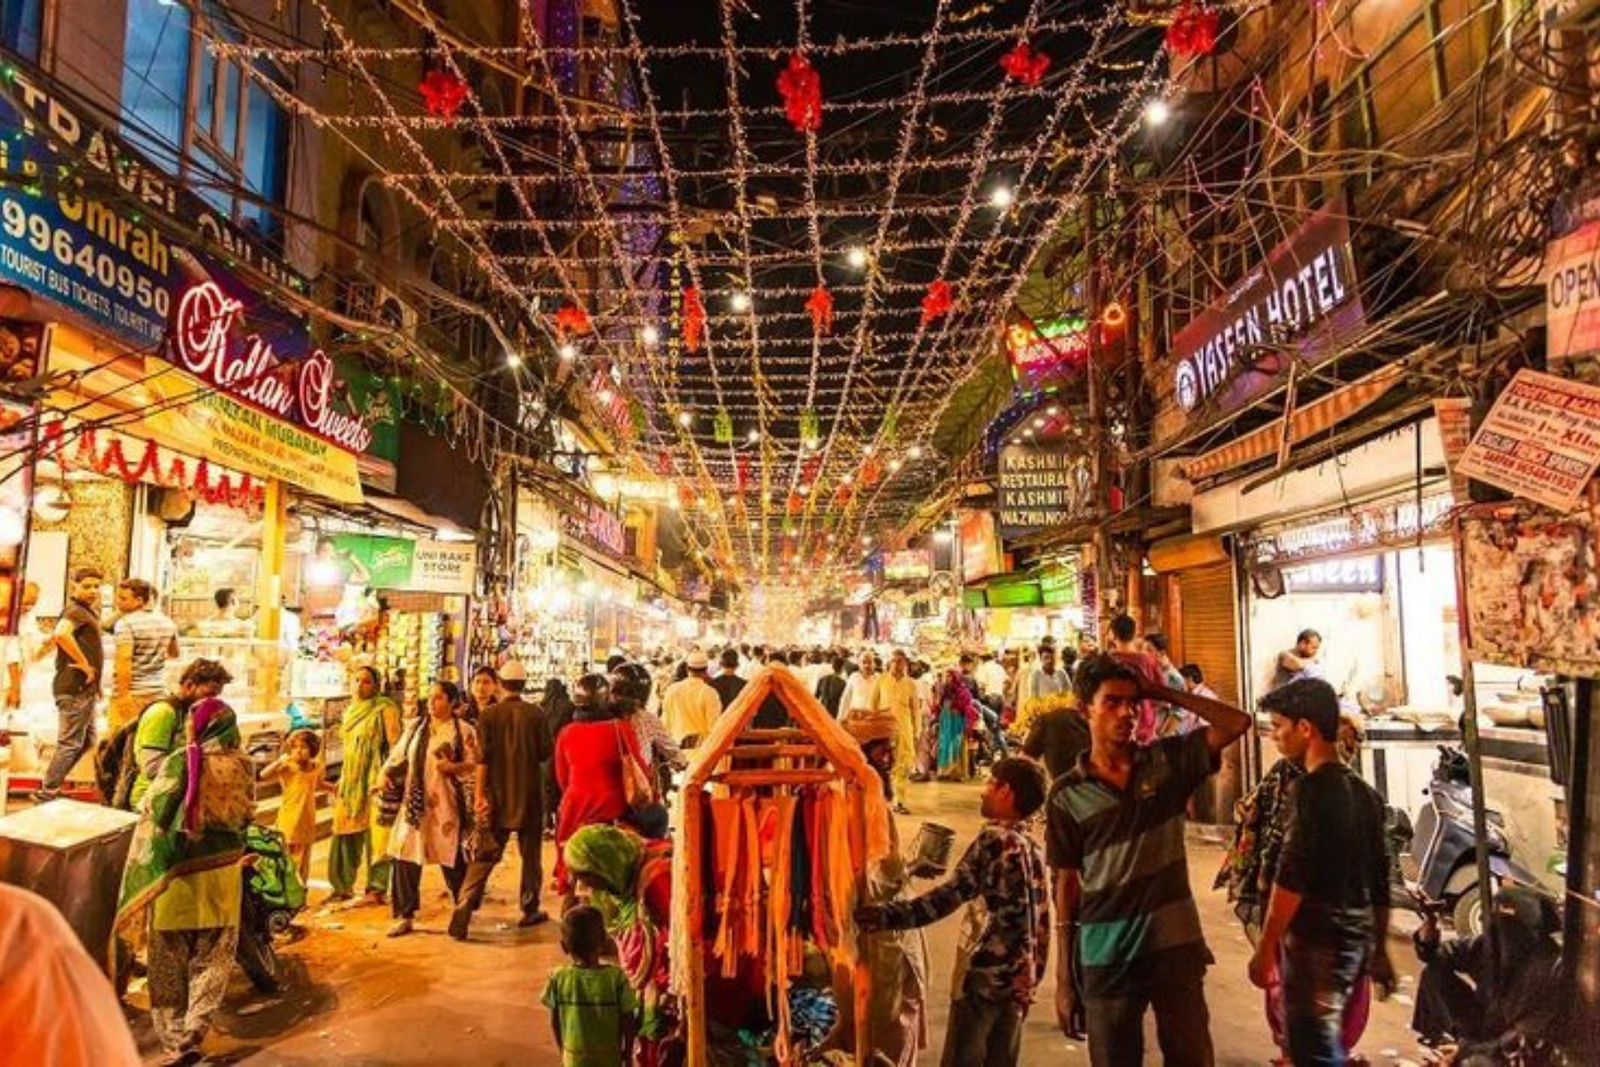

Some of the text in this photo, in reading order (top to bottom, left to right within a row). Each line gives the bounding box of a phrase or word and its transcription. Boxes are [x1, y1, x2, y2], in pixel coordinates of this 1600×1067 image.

[0, 243, 46, 284] TOURIST
[49, 268, 69, 295] BUS
[2, 199, 169, 318] 99640950
[1266, 246, 1344, 345] HOTEL
[416, 551, 471, 562] UNI BAKE
[424, 562, 461, 573] STORE
